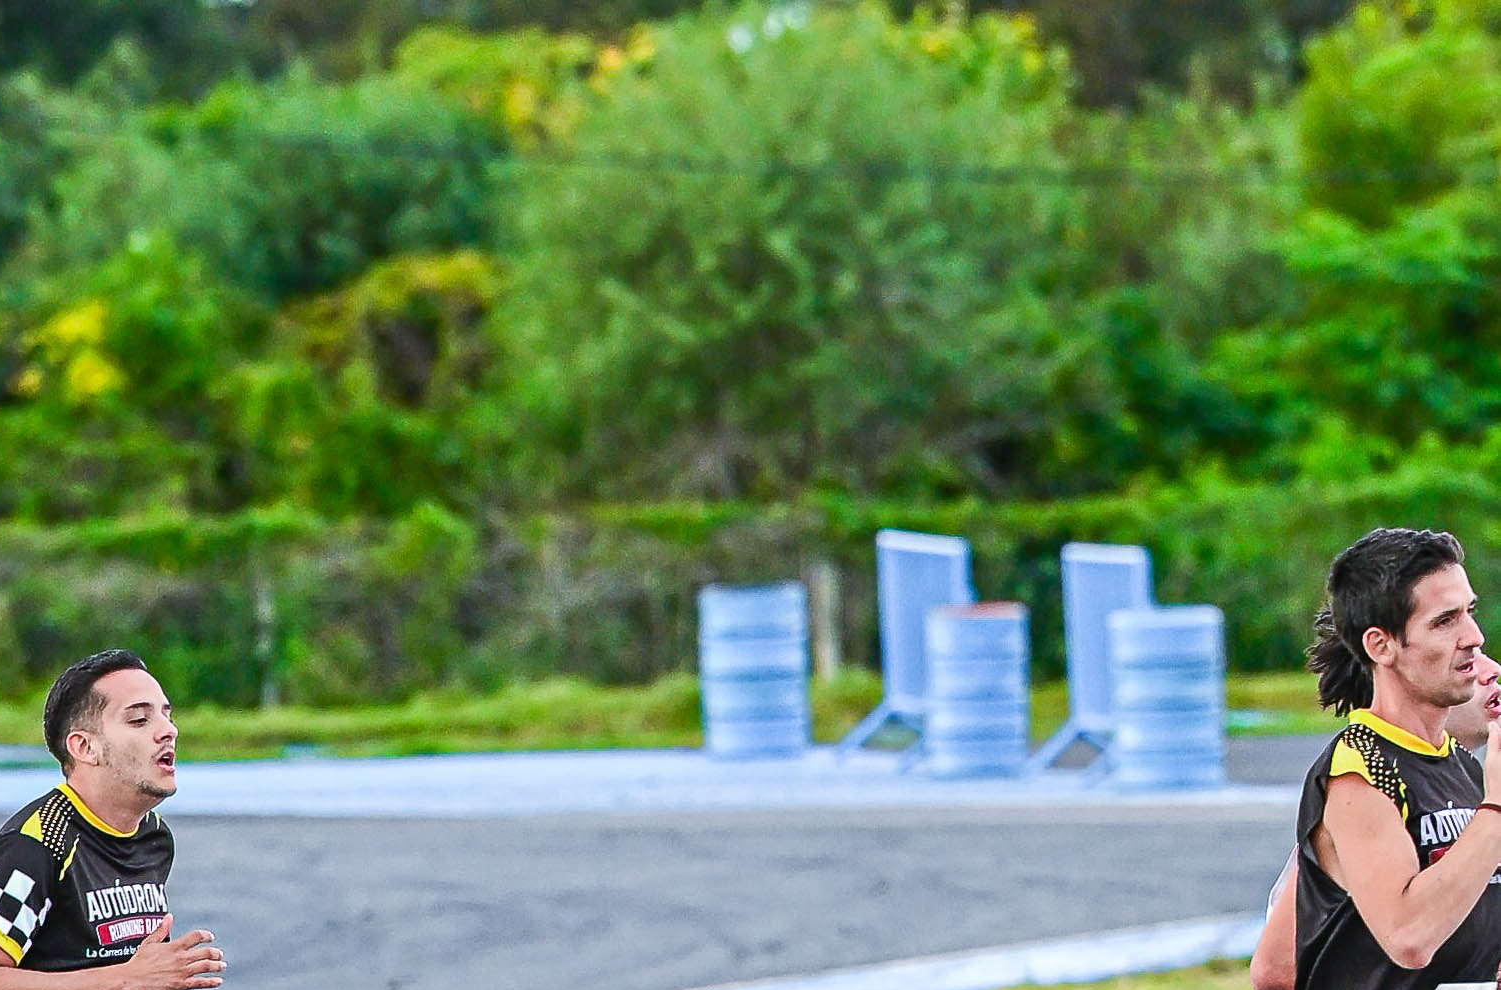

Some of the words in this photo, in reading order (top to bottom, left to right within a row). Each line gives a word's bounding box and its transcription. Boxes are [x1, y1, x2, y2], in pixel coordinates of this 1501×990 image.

[108, 919, 145, 941] RUNNING
[86, 948, 98, 957] La
[99, 948, 122, 957] Carrera
